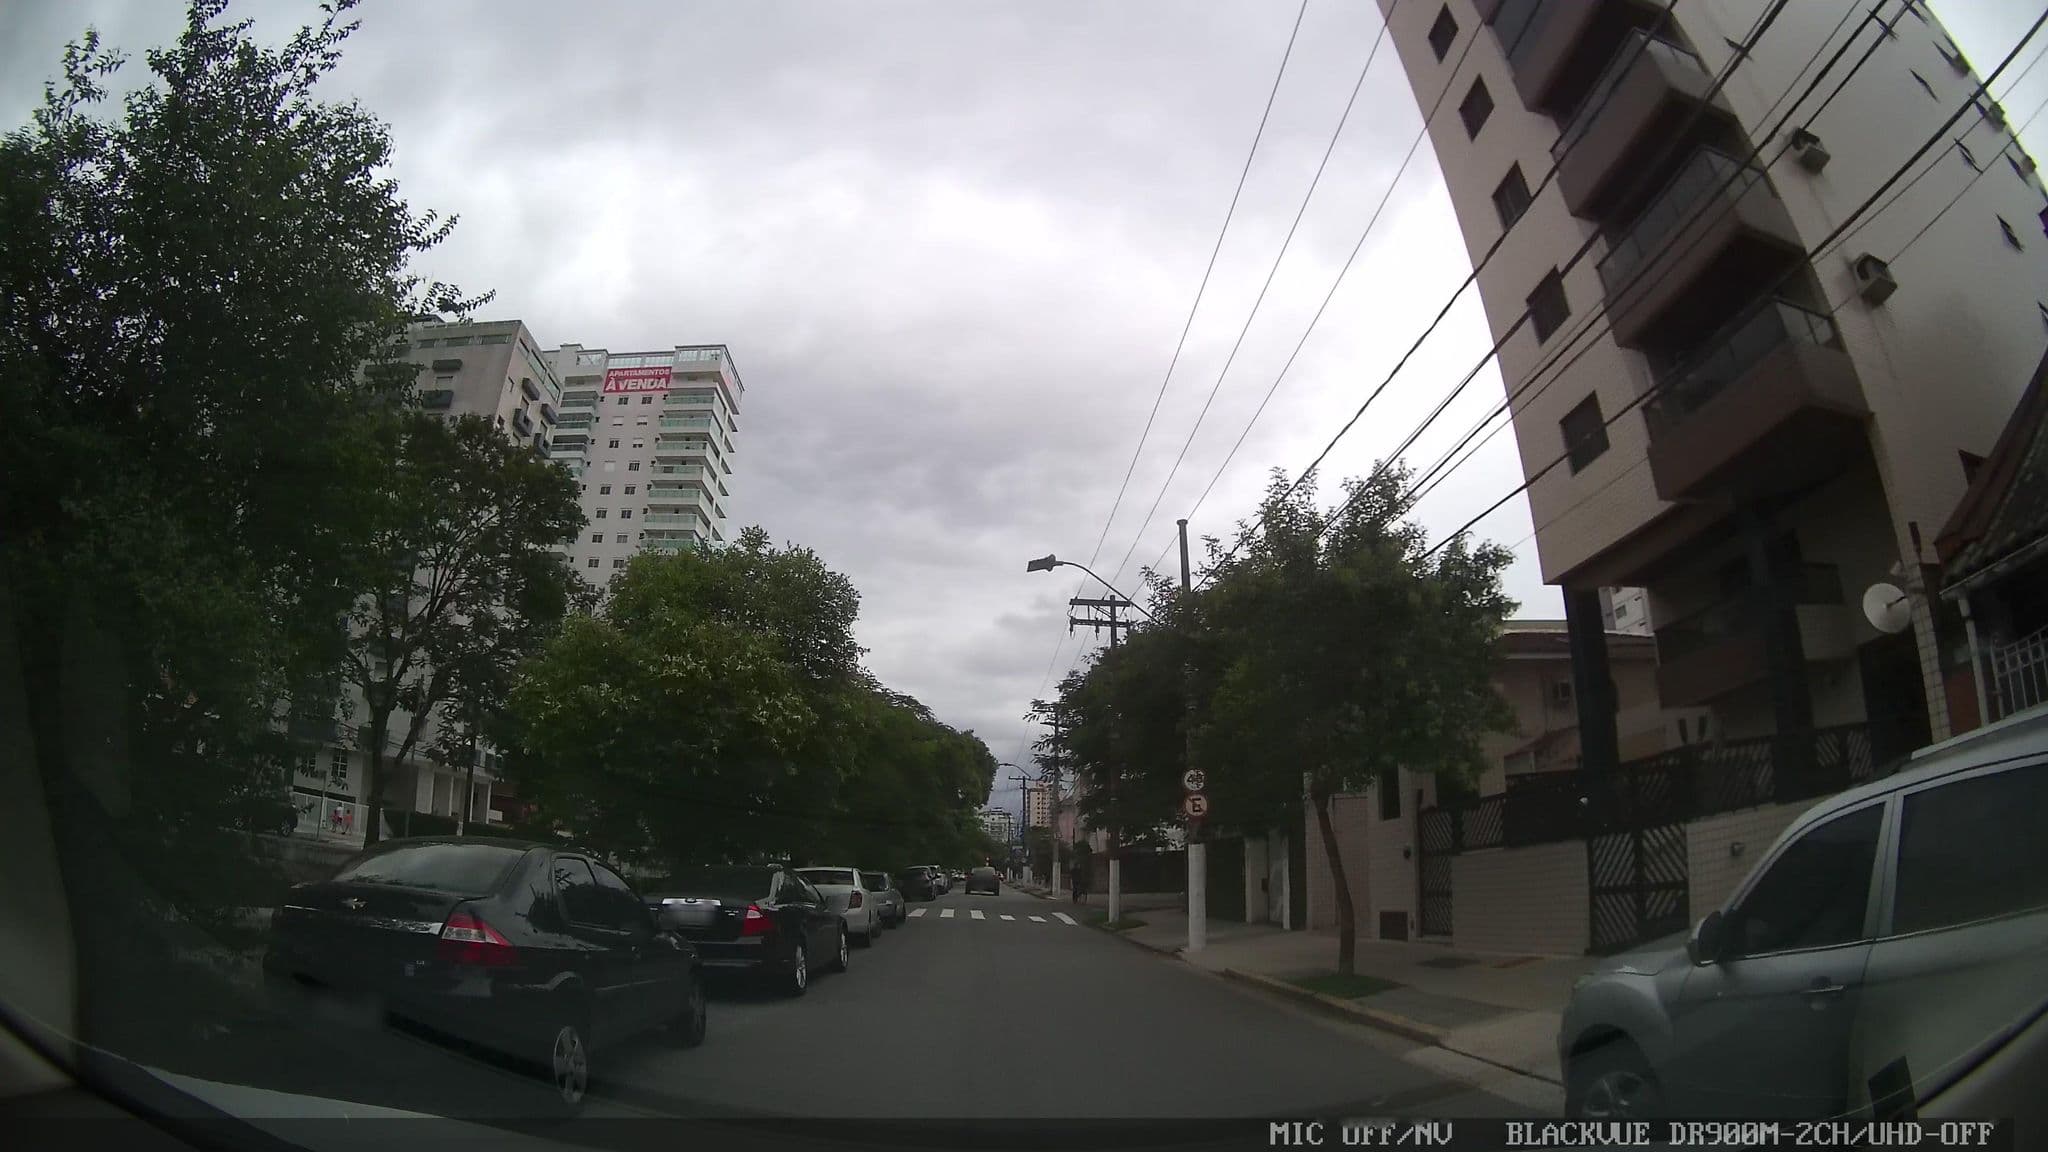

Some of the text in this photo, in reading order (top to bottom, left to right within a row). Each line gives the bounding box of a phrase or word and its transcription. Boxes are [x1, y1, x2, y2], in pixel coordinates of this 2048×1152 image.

[605, 377, 667, 391] À VENDA
[1191, 797, 1202, 813] E
